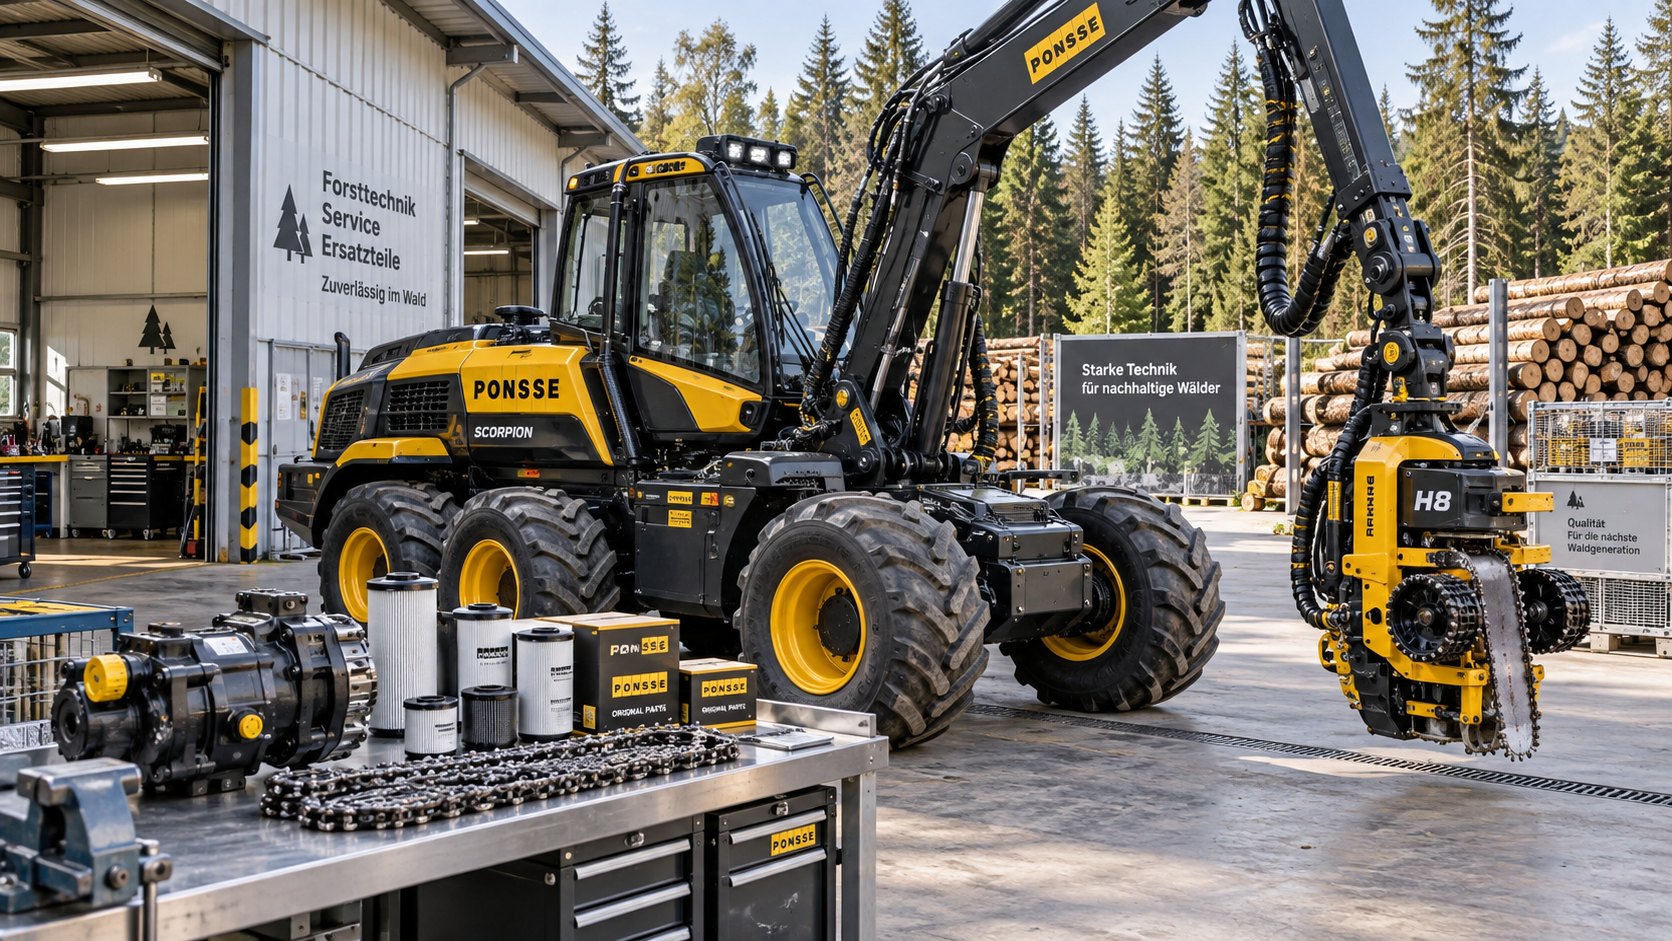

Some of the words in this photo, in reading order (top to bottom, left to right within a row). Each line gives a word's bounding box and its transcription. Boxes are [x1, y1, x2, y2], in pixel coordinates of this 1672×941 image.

[1030, 15, 1100, 74] PONSSE
[322, 169, 416, 218] Forsttechnik
[321, 201, 381, 237] Service
[321, 233, 401, 271] Ersatzteile
[321, 274, 386, 305] Zuverlässig
[387, 286, 401, 303] im
[402, 288, 427, 307] Wald
[1081, 362, 1124, 377] Starke
[1126, 362, 1178, 376] Technik
[473, 378, 560, 400] PONSSE
[1081, 381, 1100, 395] für
[1102, 381, 1175, 398] nachhaltige
[1177, 381, 1221, 395] Wälder
[473, 425, 534, 439] SCORPION
[1413, 490, 1452, 512] H8
[1567, 517, 1606, 529] Qualität
[1567, 530, 1583, 540] Für
[1584, 531, 1599, 541] die
[1567, 543, 1641, 555] Waldgeneration
[614, 679, 666, 694] PONSSE
[703, 683, 745, 694] PONSSE
[773, 831, 815, 851] PONSSE
